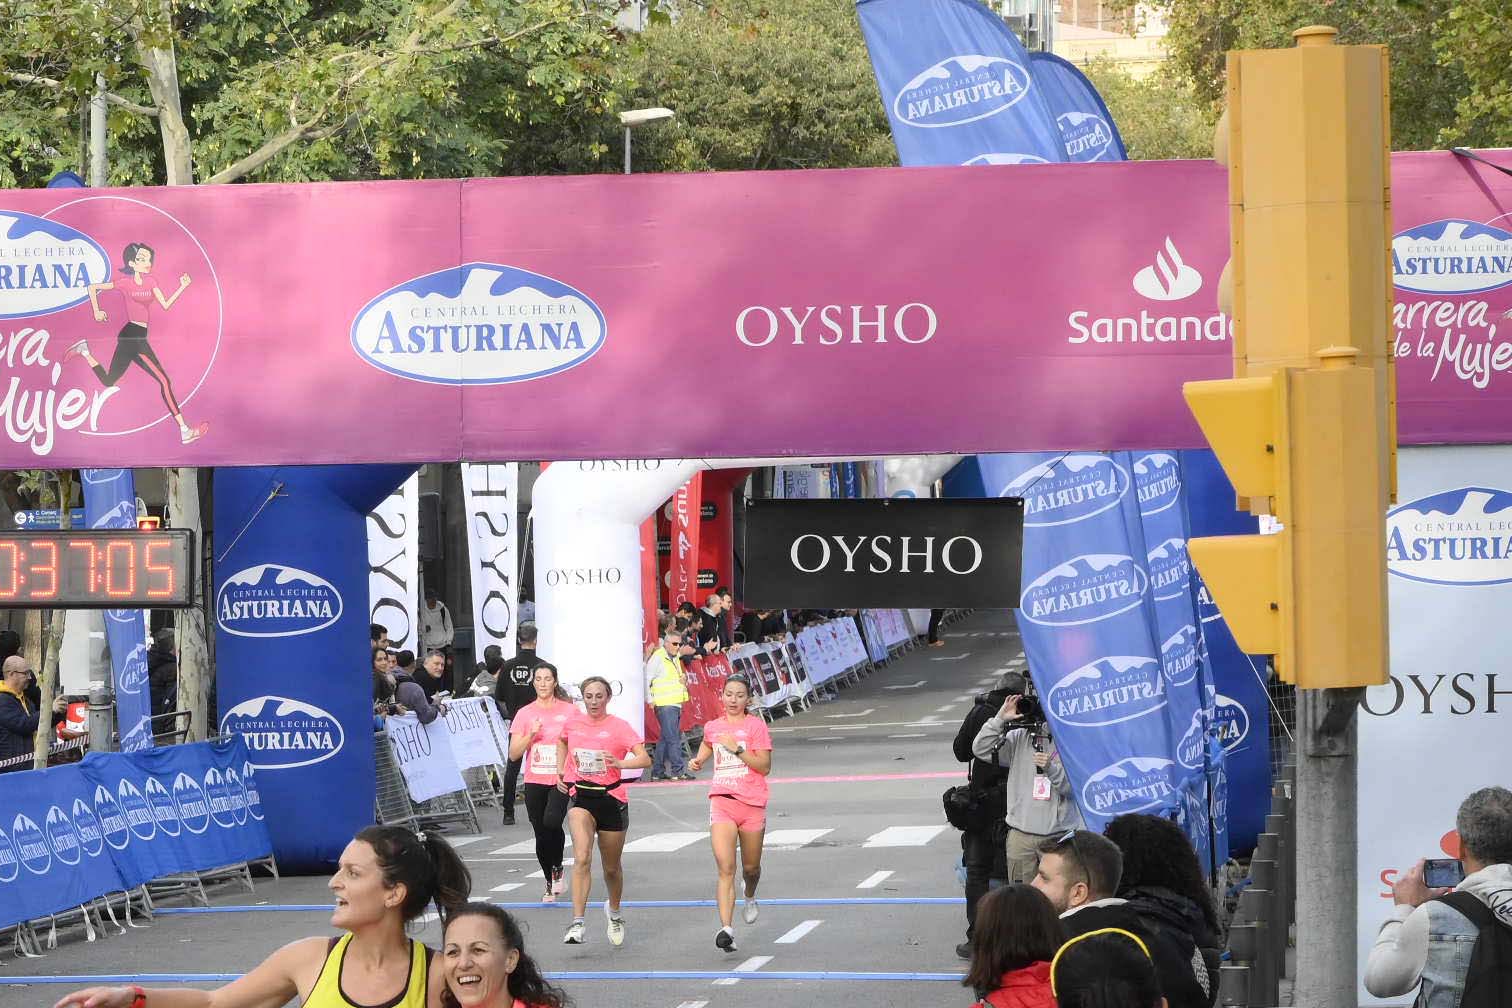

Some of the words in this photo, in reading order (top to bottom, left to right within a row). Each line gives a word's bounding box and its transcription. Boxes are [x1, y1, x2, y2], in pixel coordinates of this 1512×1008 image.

[14, 247, 86, 257] LECHERA
[411, 306, 489, 319] CENTRAL
[497, 304, 578, 316] LECHERA
[371, 310, 586, 354] ASTURIANA
[735, 302, 937, 347] OYSHO
[1068, 310, 1233, 343] Santand
[1416, 330, 1435, 357] la
[1415, 521, 1482, 532] CENTRAL
[790, 534, 983, 575] OYSHO
[545, 567, 622, 588] OYSHO
[233, 589, 277, 598] CENTRAL
[279, 588, 329, 598] LECHERA
[220, 594, 334, 622] ASTURIANA
[516, 670, 529, 679] BP
[235, 721, 276, 729] CENTRAL
[281, 720, 330, 729] LECHERA
